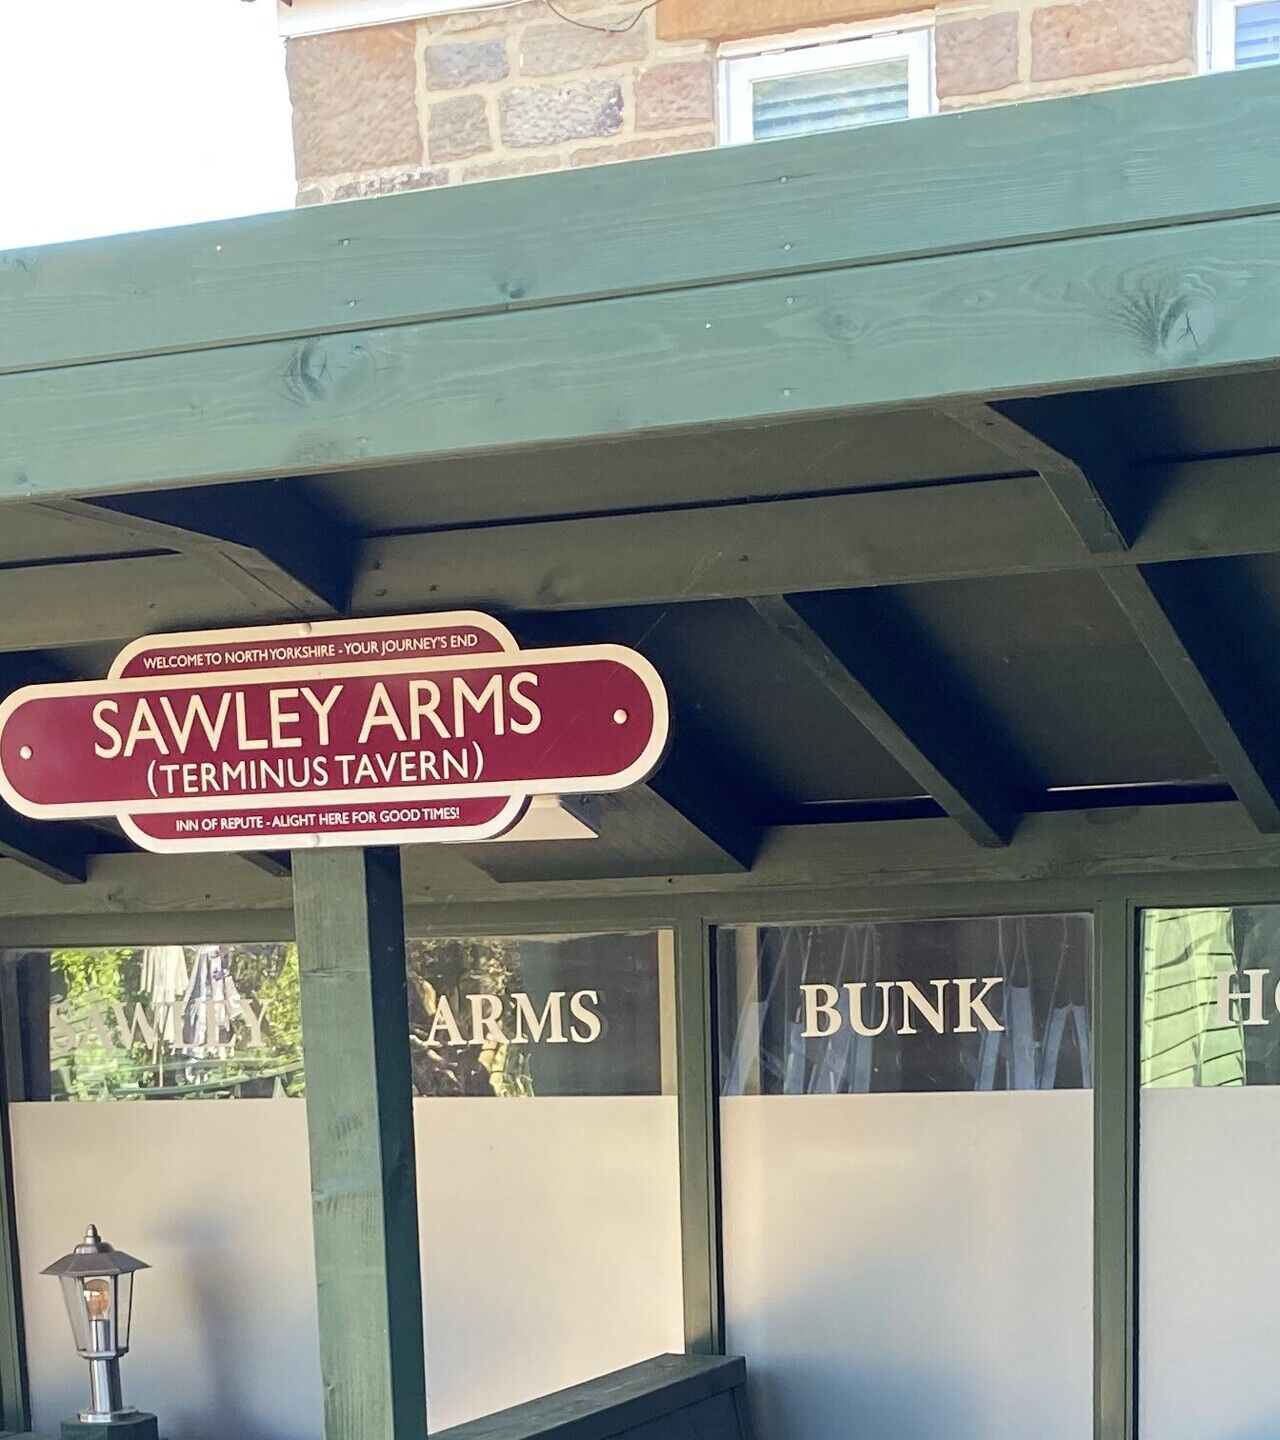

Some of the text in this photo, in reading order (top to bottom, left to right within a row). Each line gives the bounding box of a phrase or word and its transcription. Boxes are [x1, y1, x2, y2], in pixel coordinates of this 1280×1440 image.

[143, 653, 204, 669] WELCOME
[204, 651, 221, 666] TO
[225, 649, 269, 665] NORTH
[269, 644, 335, 661] YORKSHIRE
[343, 641, 379, 656] YOUR
[381, 636, 447, 656] JOURNEY'S
[450, 634, 478, 648] END
[92, 671, 543, 759] SAWLEY ARMS
[145, 740, 485, 798] (TERMINUS TAVERN)
[175, 819, 199, 832] INN
[201, 818, 218, 831] OF
[220, 816, 263, 830] REPUTE
[272, 813, 316, 828] ALIGHT
[318, 811, 350, 826] HERE
[352, 810, 377, 824] FOR
[379, 808, 420, 822] GOOD
[422, 806, 460, 820] TIMES!
[427, 989, 602, 1046] ARMS
[799, 976, 1006, 1037] BUNK
